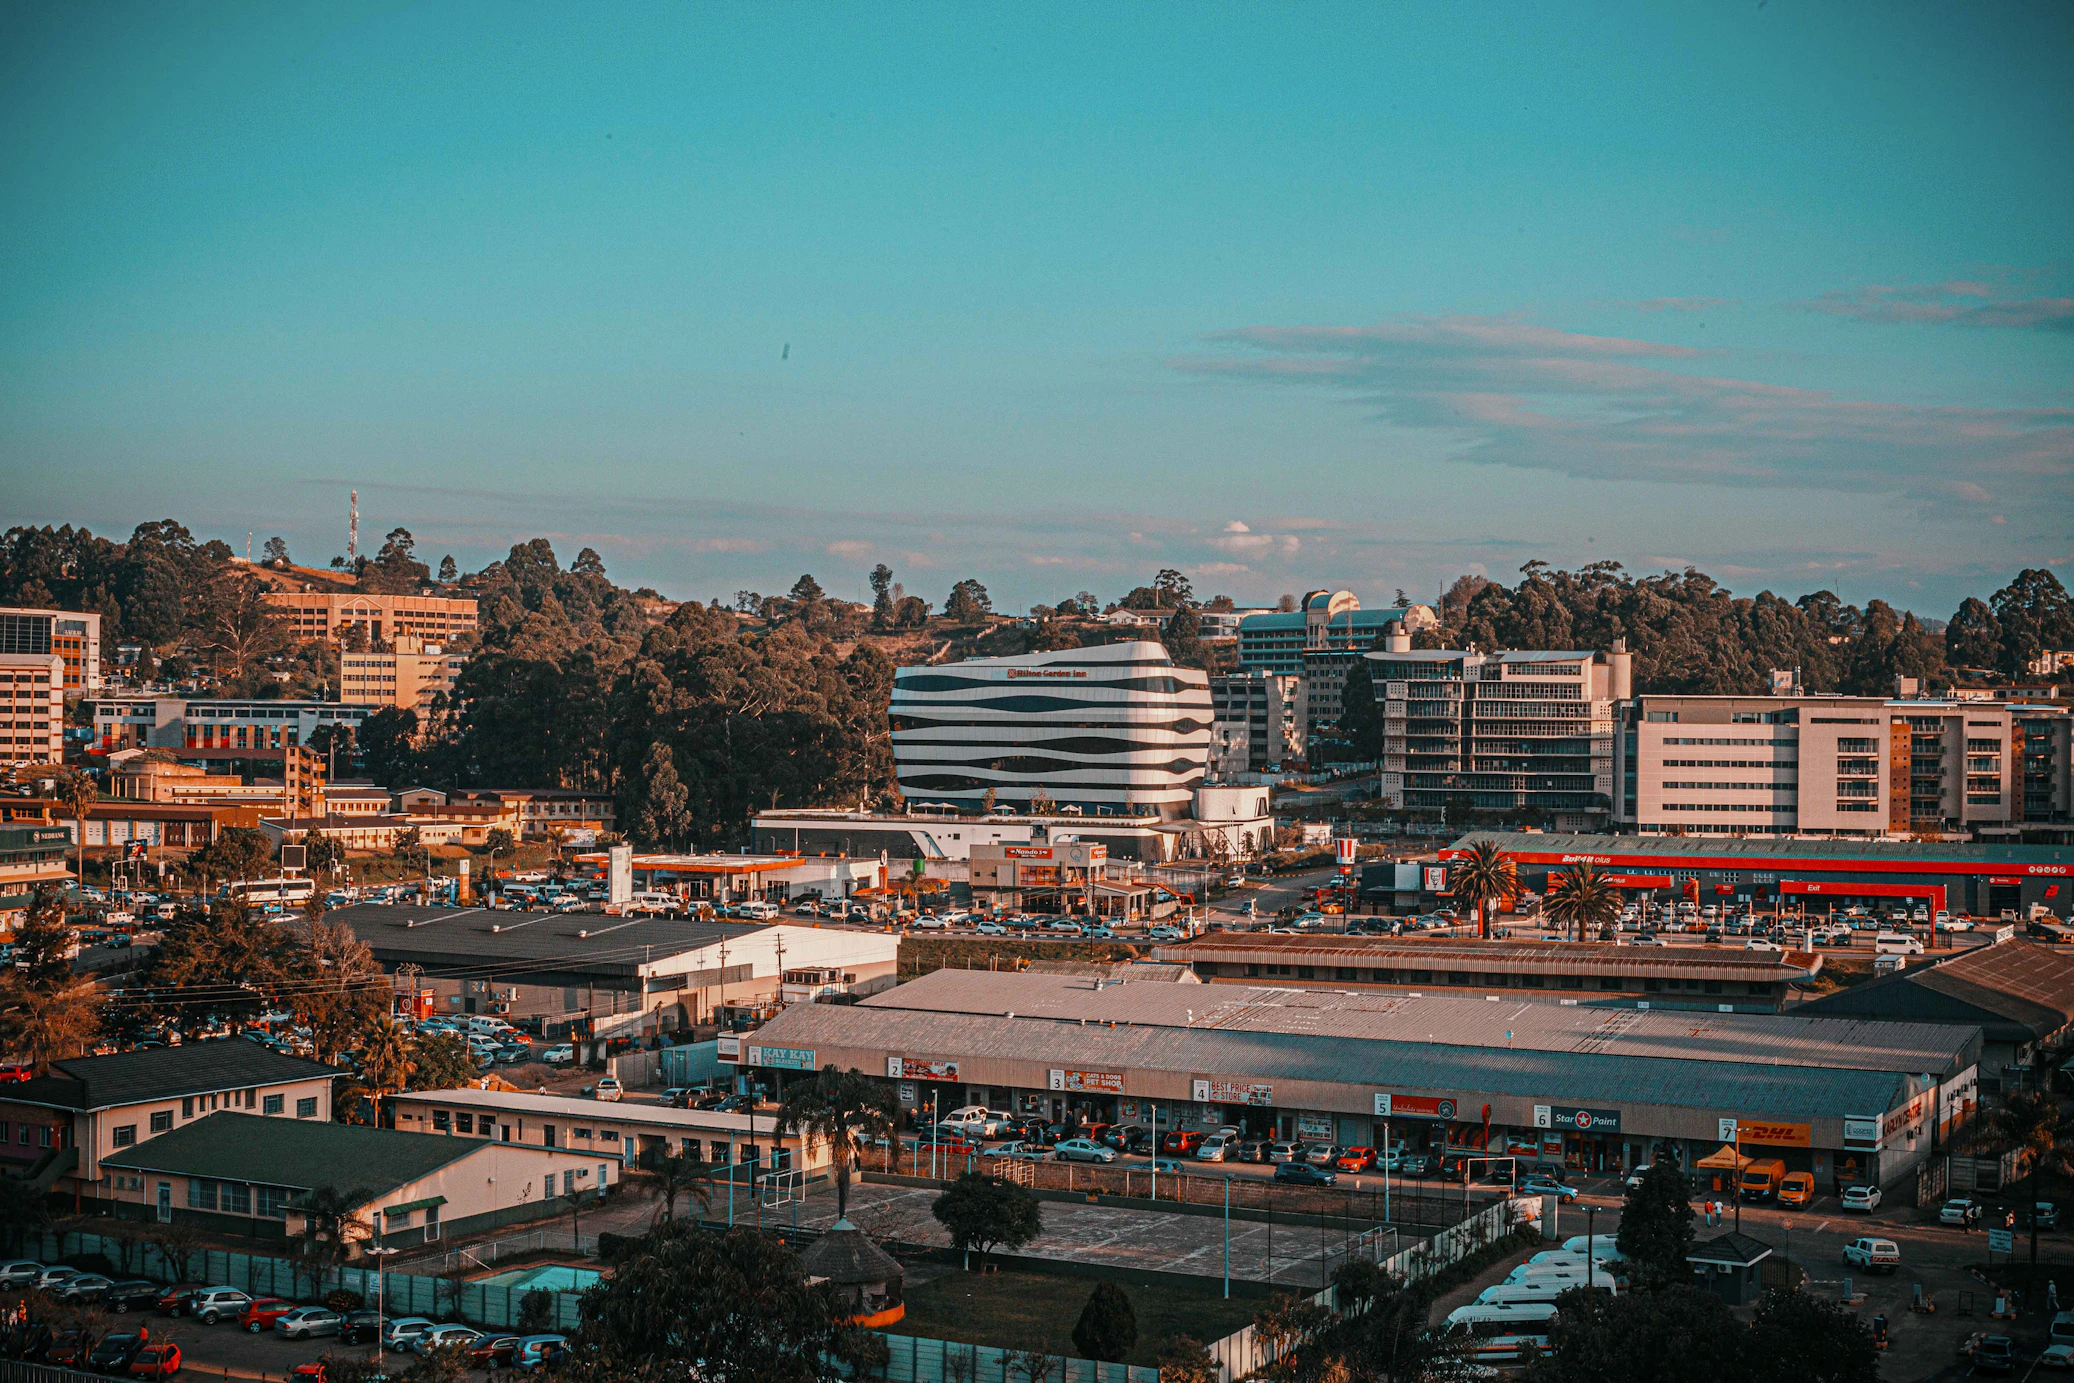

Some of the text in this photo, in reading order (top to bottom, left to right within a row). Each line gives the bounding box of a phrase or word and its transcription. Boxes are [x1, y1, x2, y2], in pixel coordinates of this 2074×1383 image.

[1017, 669, 1087, 677] Hilton Garden Inn
[1807, 884, 1821, 892] Exit
[752, 1054, 758, 1064] 1
[763, 1047, 787, 1059] KAY
[789, 1049, 814, 1061] KAY
[892, 1065, 898, 1076] 2
[1054, 1078, 1061, 1089] 3
[1086, 1078, 1122, 1088] PET SHOP
[1211, 1081, 1229, 1092] BEST
[1230, 1083, 1251, 1094] PRICE
[1197, 1089, 1205, 1100] 4
[1220, 1091, 1241, 1101] STORE
[1379, 1102, 1386, 1114] 5
[1538, 1114, 1546, 1126] 6
[1555, 1113, 1617, 1126] Star Paint
[1723, 1126, 1732, 1139] 7
[1752, 1126, 1797, 1140] DHL
